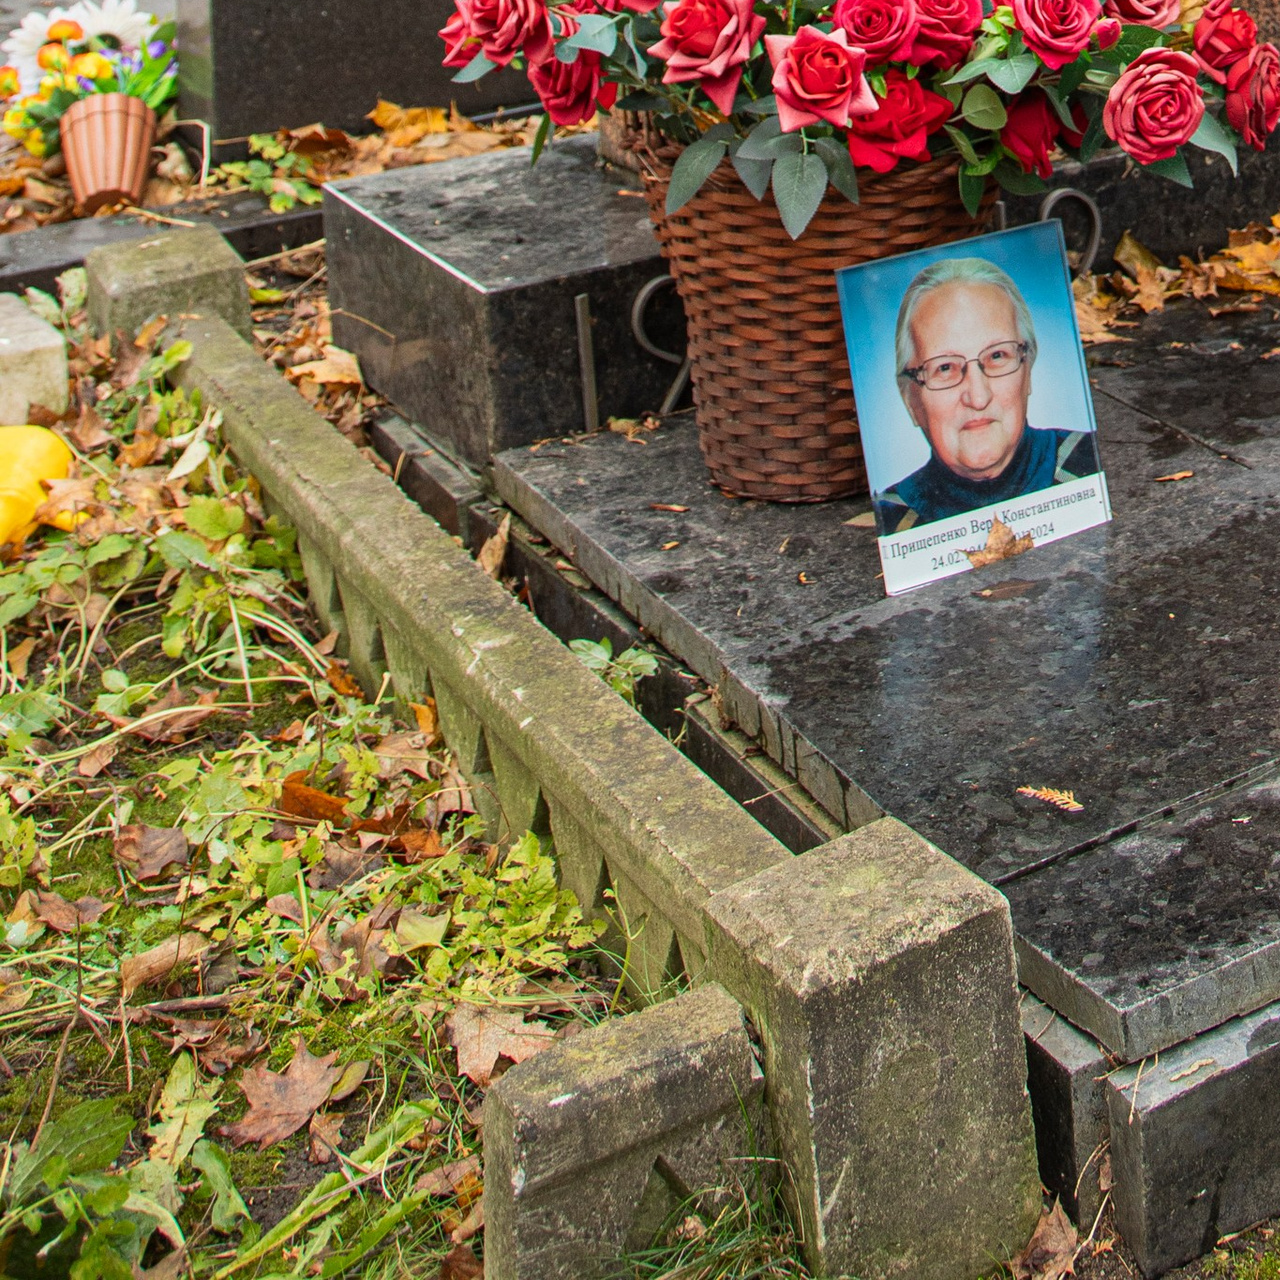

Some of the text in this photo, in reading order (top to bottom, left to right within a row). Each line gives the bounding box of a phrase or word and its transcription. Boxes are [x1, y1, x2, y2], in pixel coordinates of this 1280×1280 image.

[891, 488, 1096, 559] Прищепенко Вер Константиновна
